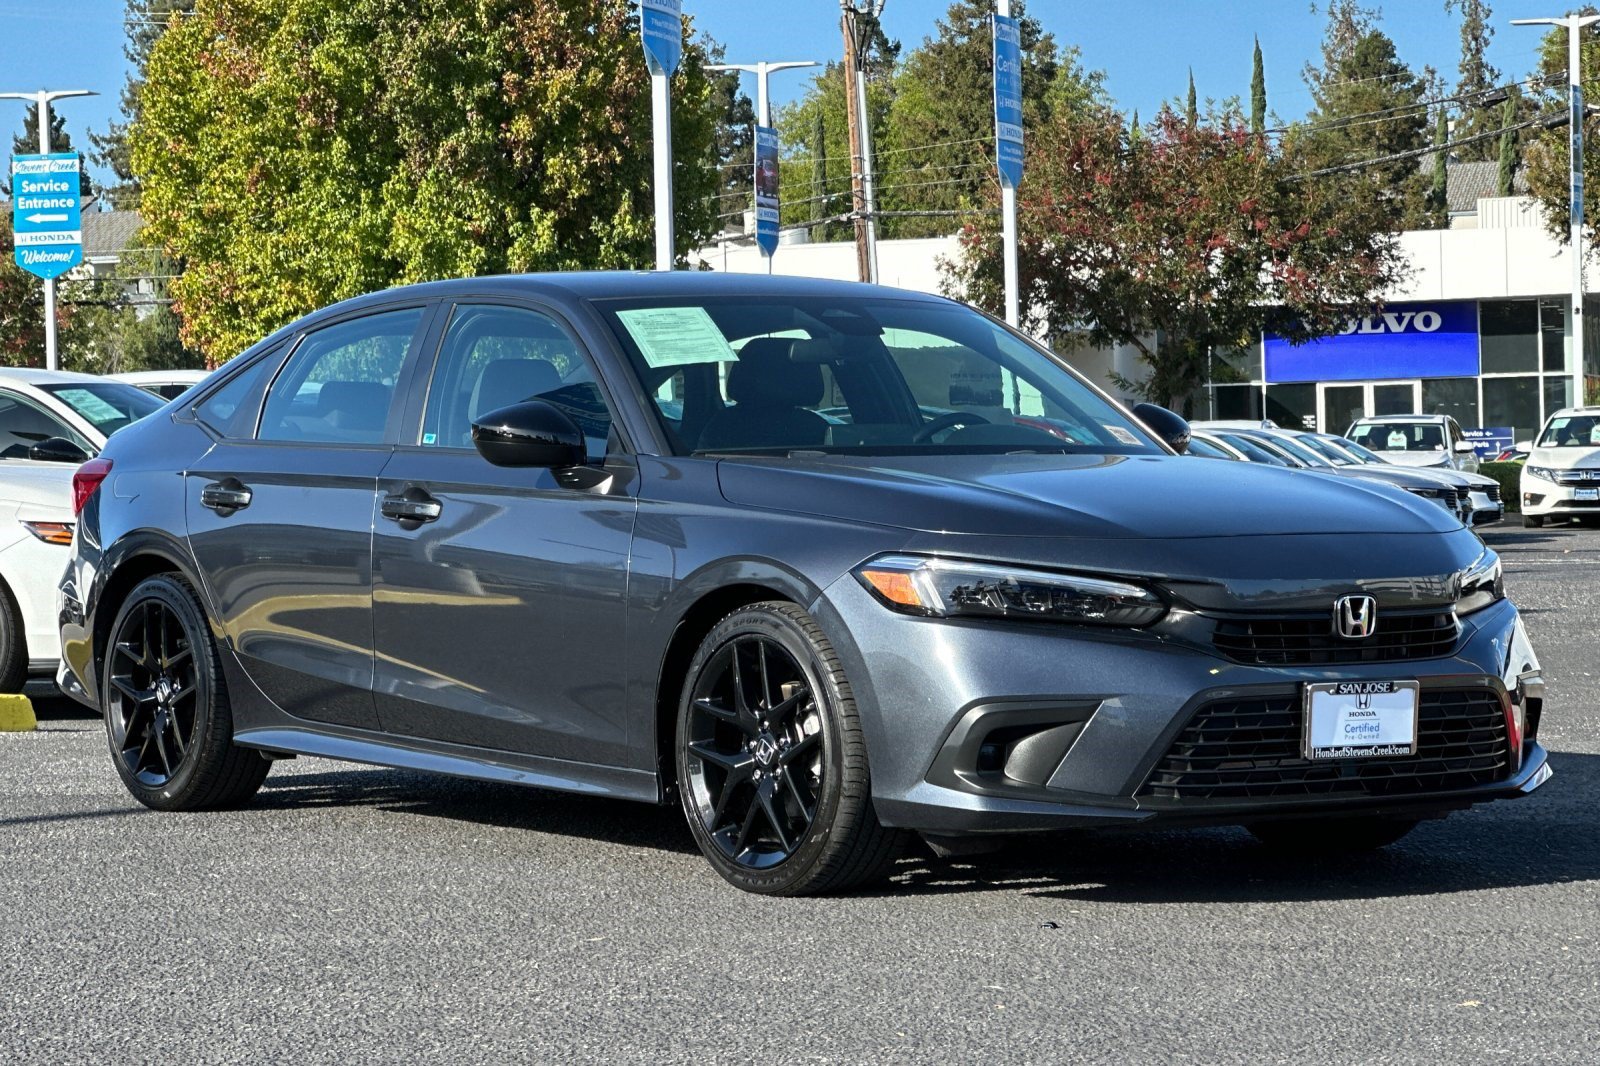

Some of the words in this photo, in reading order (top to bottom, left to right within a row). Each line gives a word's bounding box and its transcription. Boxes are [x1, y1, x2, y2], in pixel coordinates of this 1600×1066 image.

[48, 160, 77, 172] Creek
[21, 179, 70, 193] Service
[18, 197, 75, 209] Entrance
[30, 233, 75, 242] HONDA
[21, 249, 75, 265] Welcome!
[1339, 684, 1361, 694] SAN
[1362, 682, 1391, 694] JOSE
[1344, 722, 1380, 733] Certified
[1315, 744, 1410, 759] HondaofStevensCreek.com
